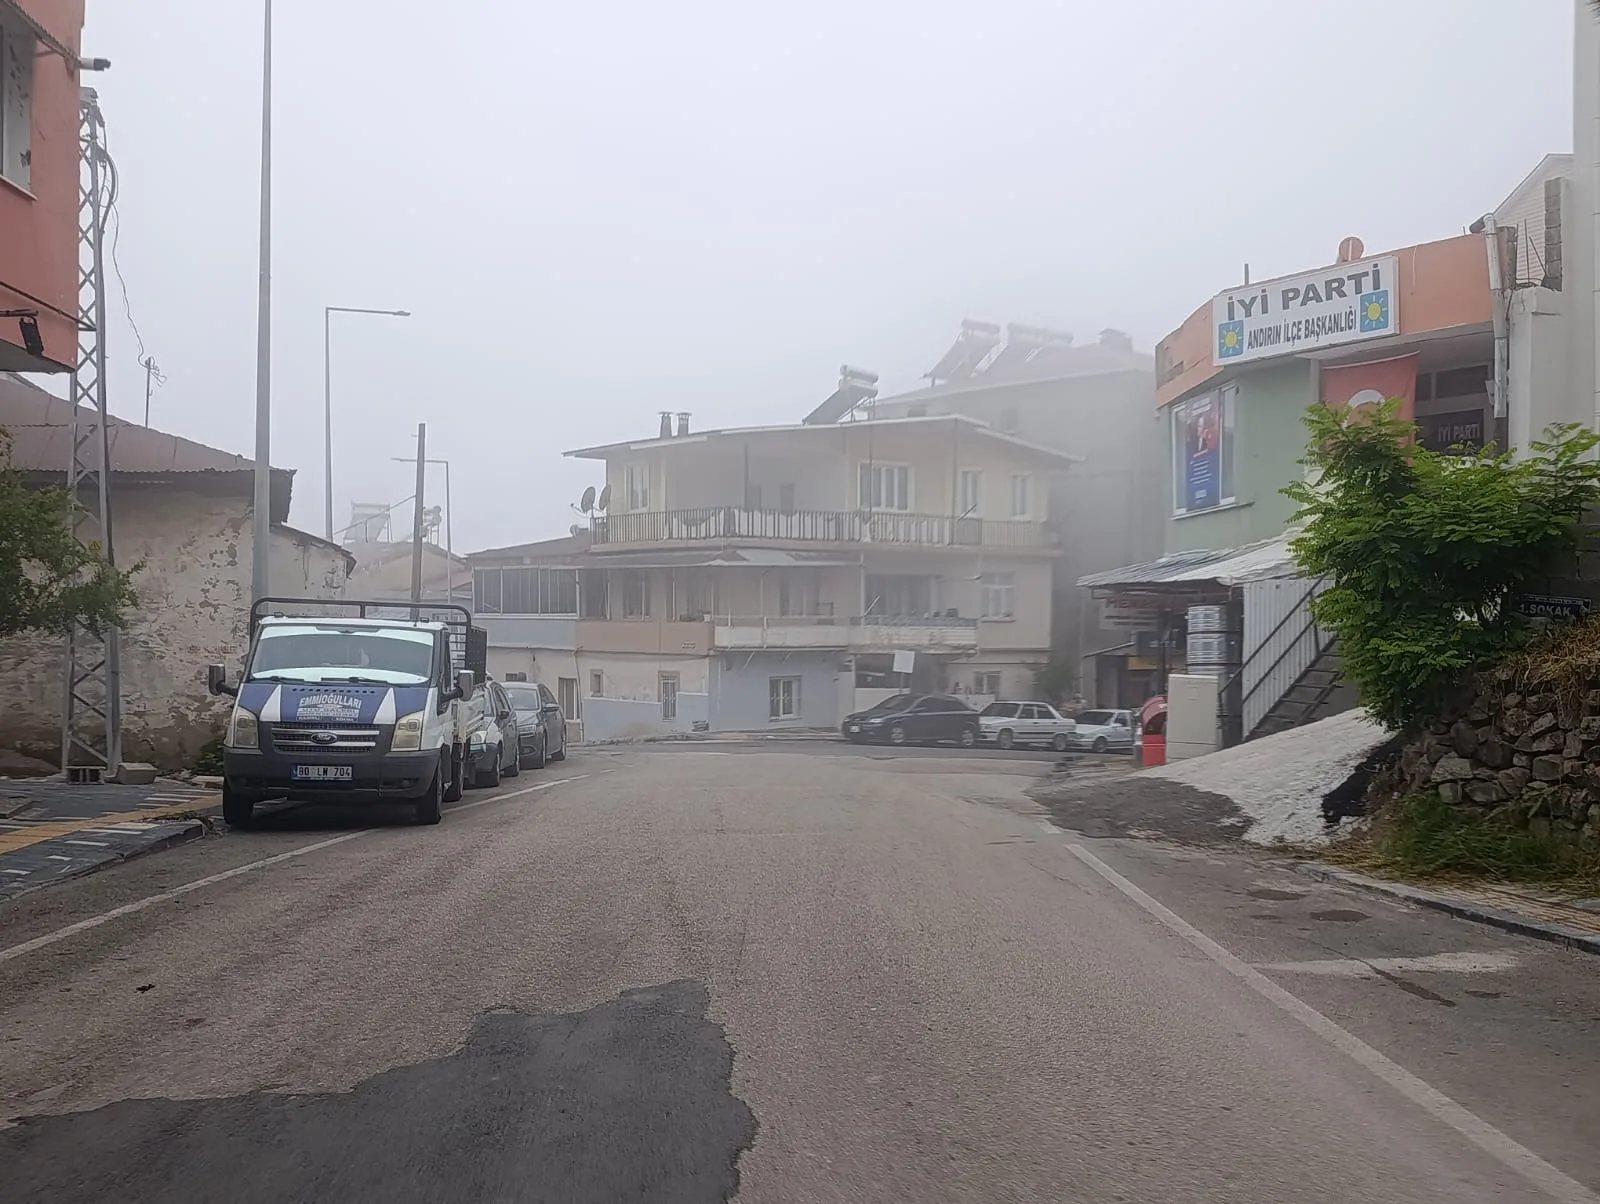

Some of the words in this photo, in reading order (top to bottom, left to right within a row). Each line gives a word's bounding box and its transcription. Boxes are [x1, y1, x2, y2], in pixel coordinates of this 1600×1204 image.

[1227, 288, 1269, 321] İYİ
[1281, 263, 1381, 311] PARTİ
[1247, 323, 1282, 350] ANDIRIN
[1283, 318, 1303, 348] İLÇE
[1304, 305, 1357, 343] BAŞKANLIĞI
[334, 767, 350, 777] 704
